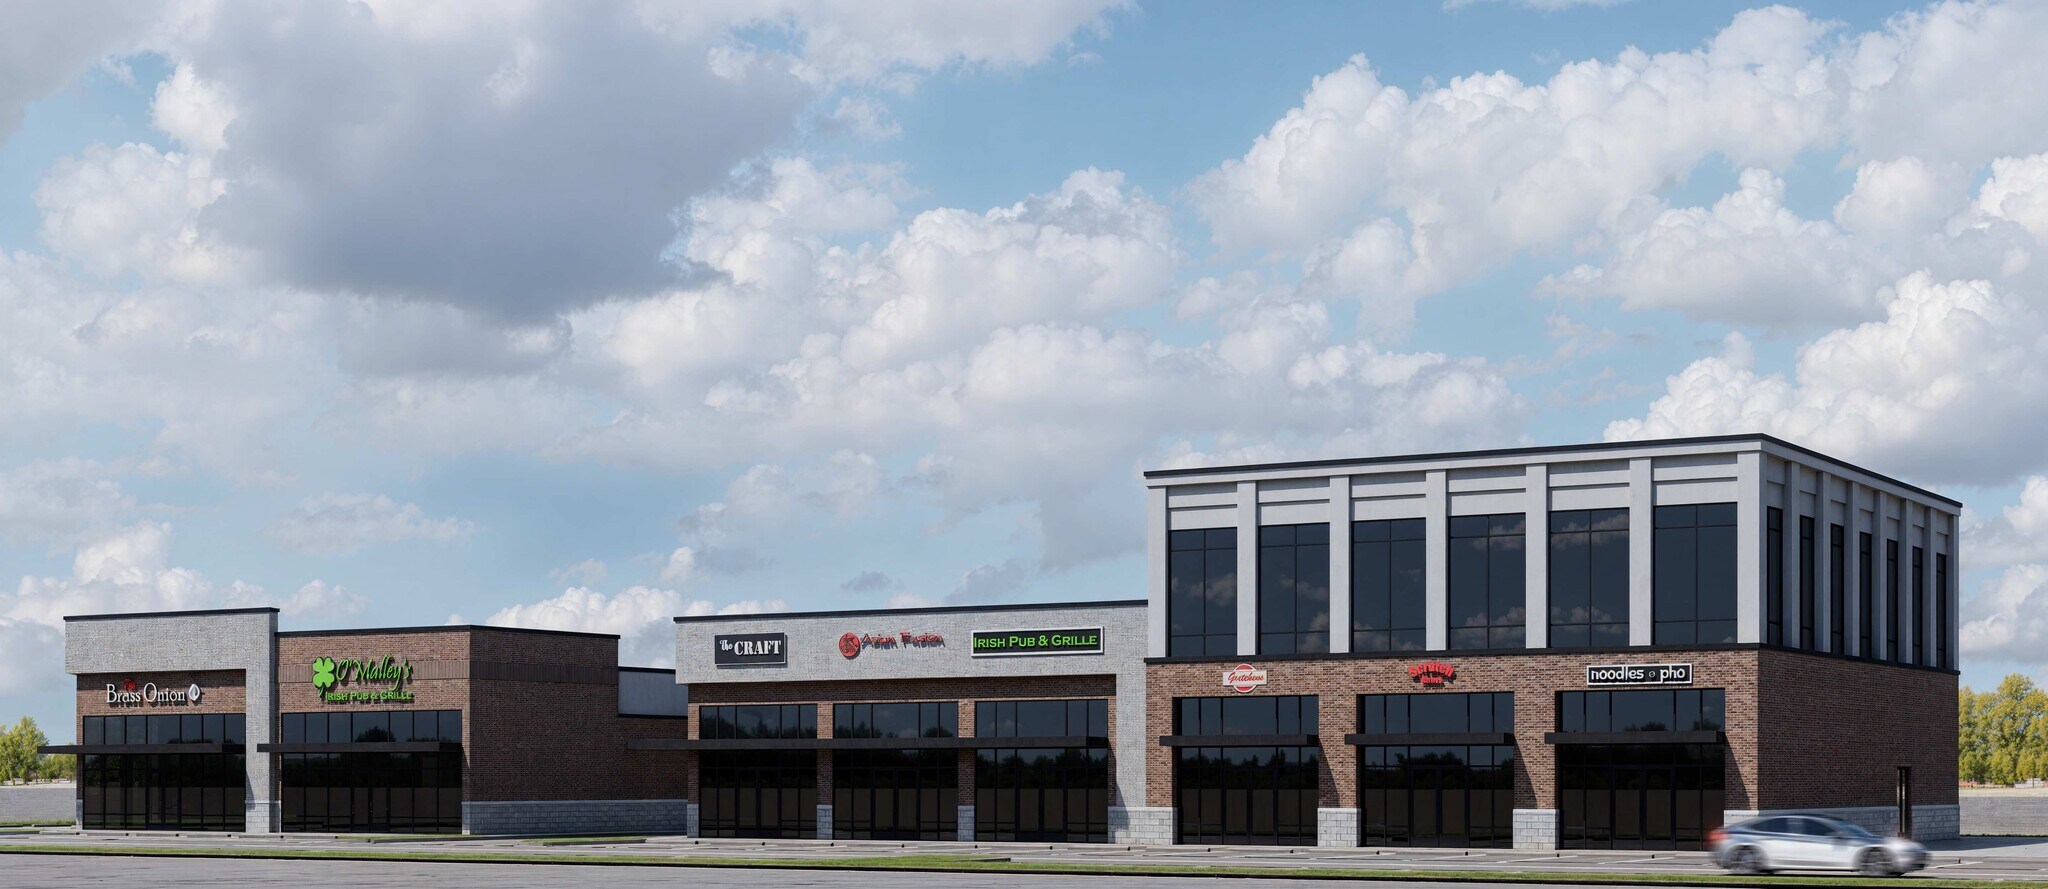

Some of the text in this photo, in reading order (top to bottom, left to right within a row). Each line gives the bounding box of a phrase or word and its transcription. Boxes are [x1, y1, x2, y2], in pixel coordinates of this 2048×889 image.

[900, 631, 942, 643] Fusion
[973, 635, 1098, 648] IRISH PUB & GRILLE
[734, 640, 781, 655] CRAFT
[1591, 665, 1686, 683] noodles pho
[106, 683, 141, 703] Brass
[143, 682, 186, 702] Onion
[325, 692, 348, 700] IRISH
[350, 691, 369, 699] PUB
[370, 691, 378, 699] &
